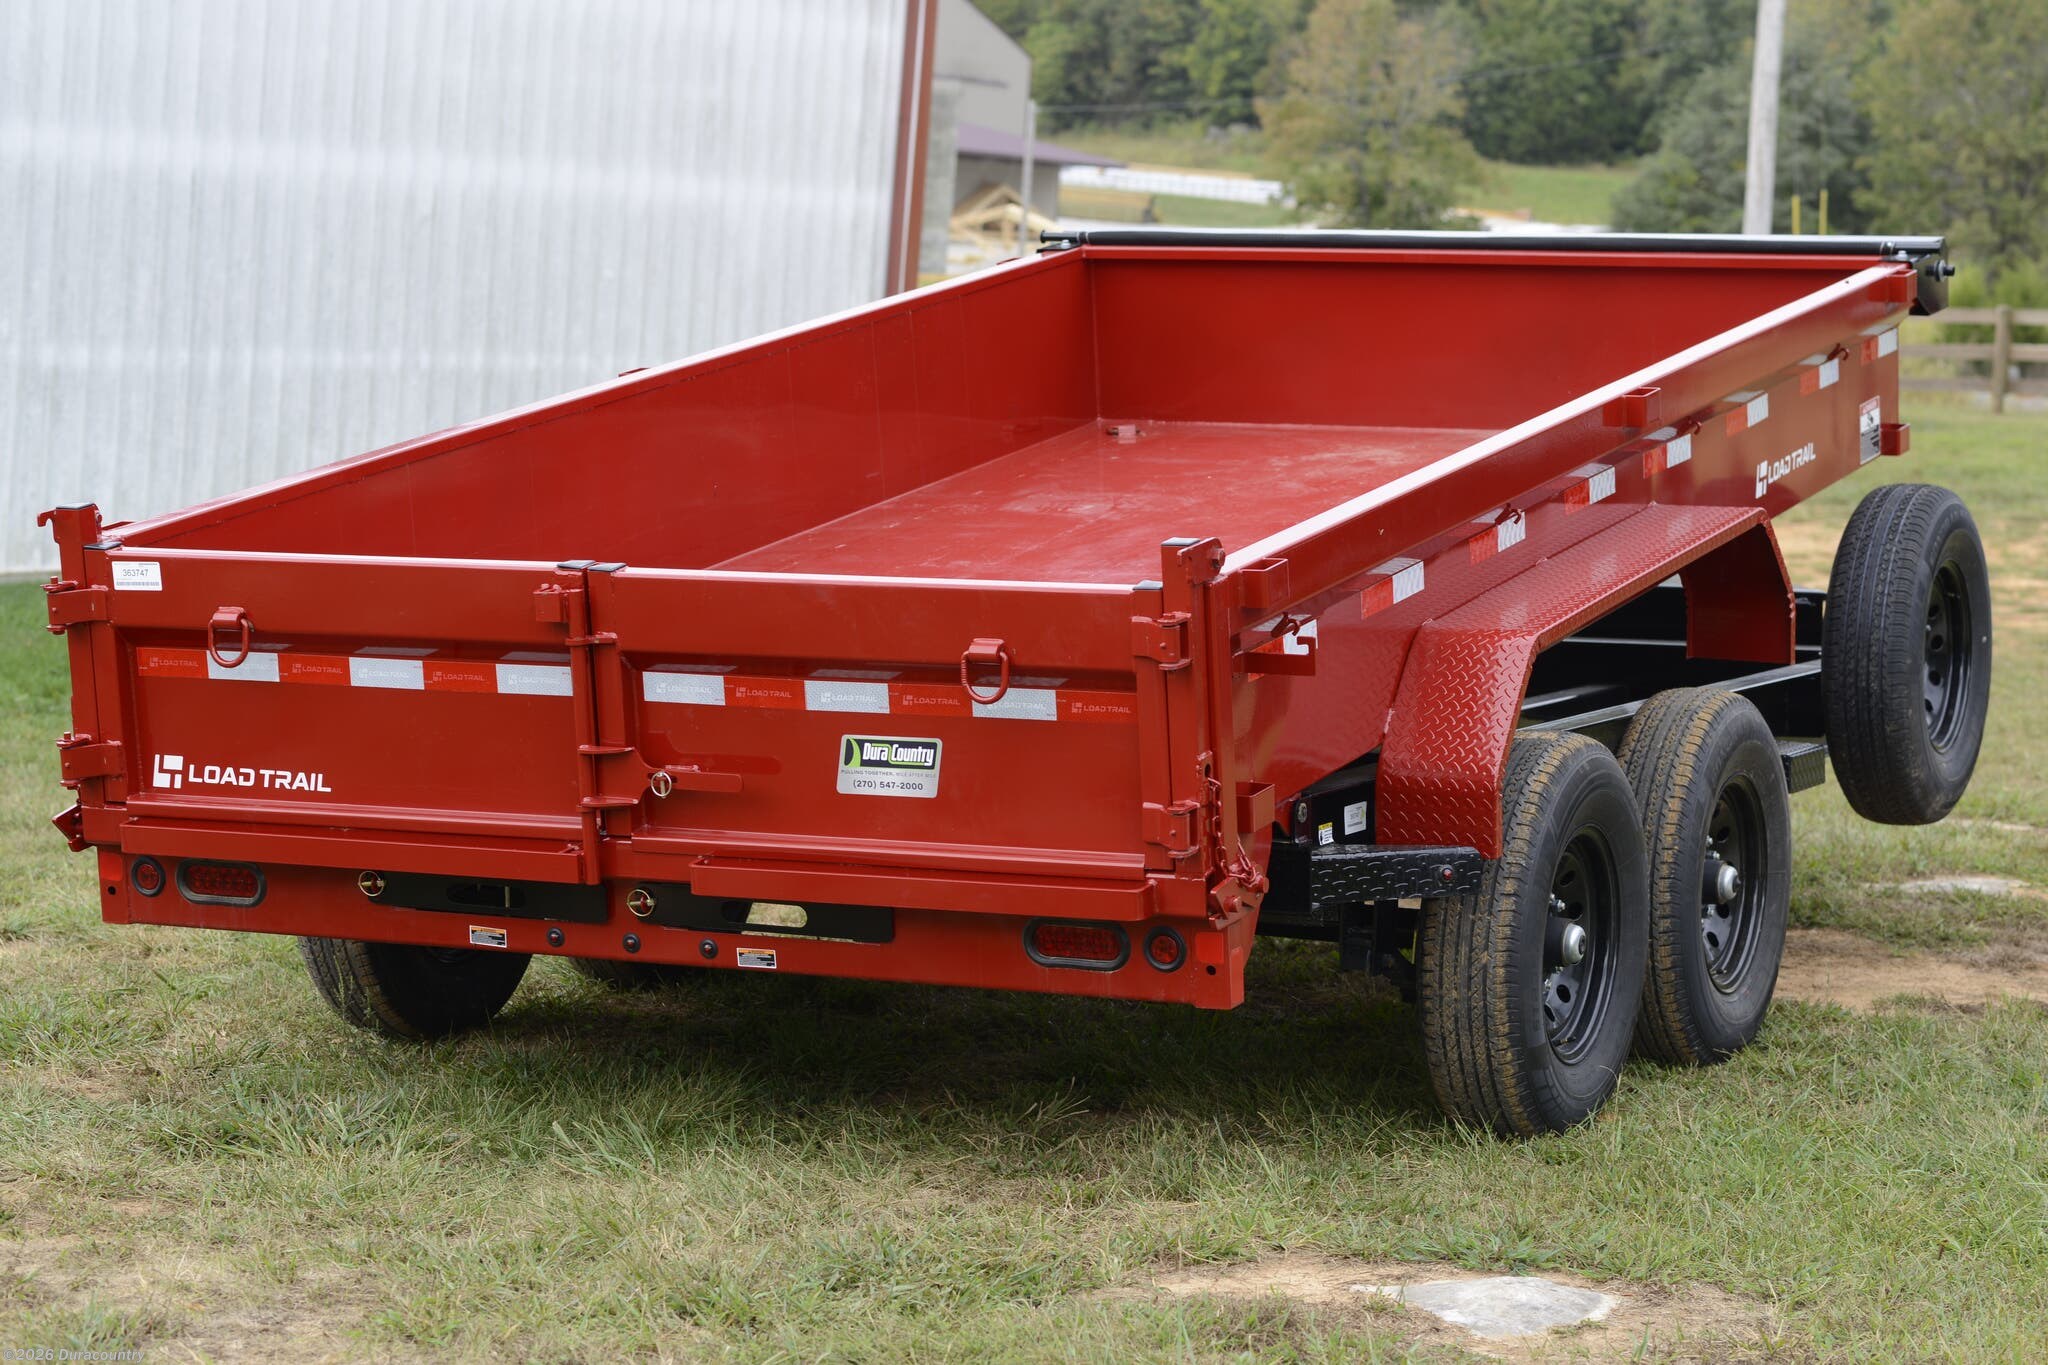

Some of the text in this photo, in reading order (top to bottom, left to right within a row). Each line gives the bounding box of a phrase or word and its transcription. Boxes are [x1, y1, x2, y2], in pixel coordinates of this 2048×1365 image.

[1768, 443, 1816, 484] LOAD TRAIL
[937, 698, 961, 706] TRAIL
[1107, 706, 1131, 714] TRAIL
[862, 743, 935, 767] Dura Country
[188, 764, 332, 792] LOAD TRAIL
[853, 779, 924, 790] (270) 547-2000
